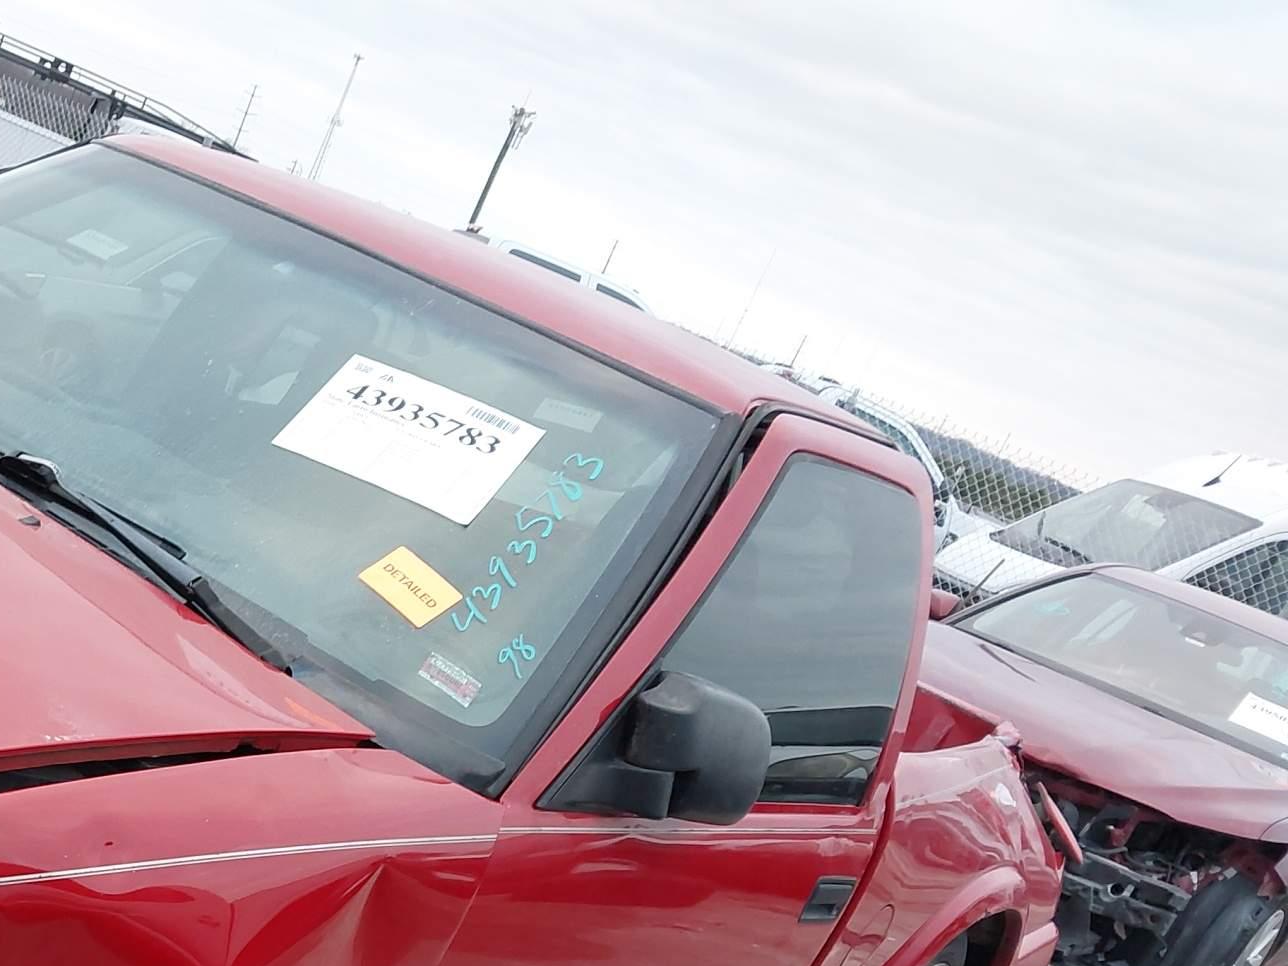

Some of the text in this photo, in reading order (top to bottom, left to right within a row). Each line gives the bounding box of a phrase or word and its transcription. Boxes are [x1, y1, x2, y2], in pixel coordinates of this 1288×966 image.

[346, 384, 501, 454] 43935783
[451, 453, 604, 632] 43935783
[383, 563, 438, 609] DETAILED
[498, 633, 536, 680] 98
